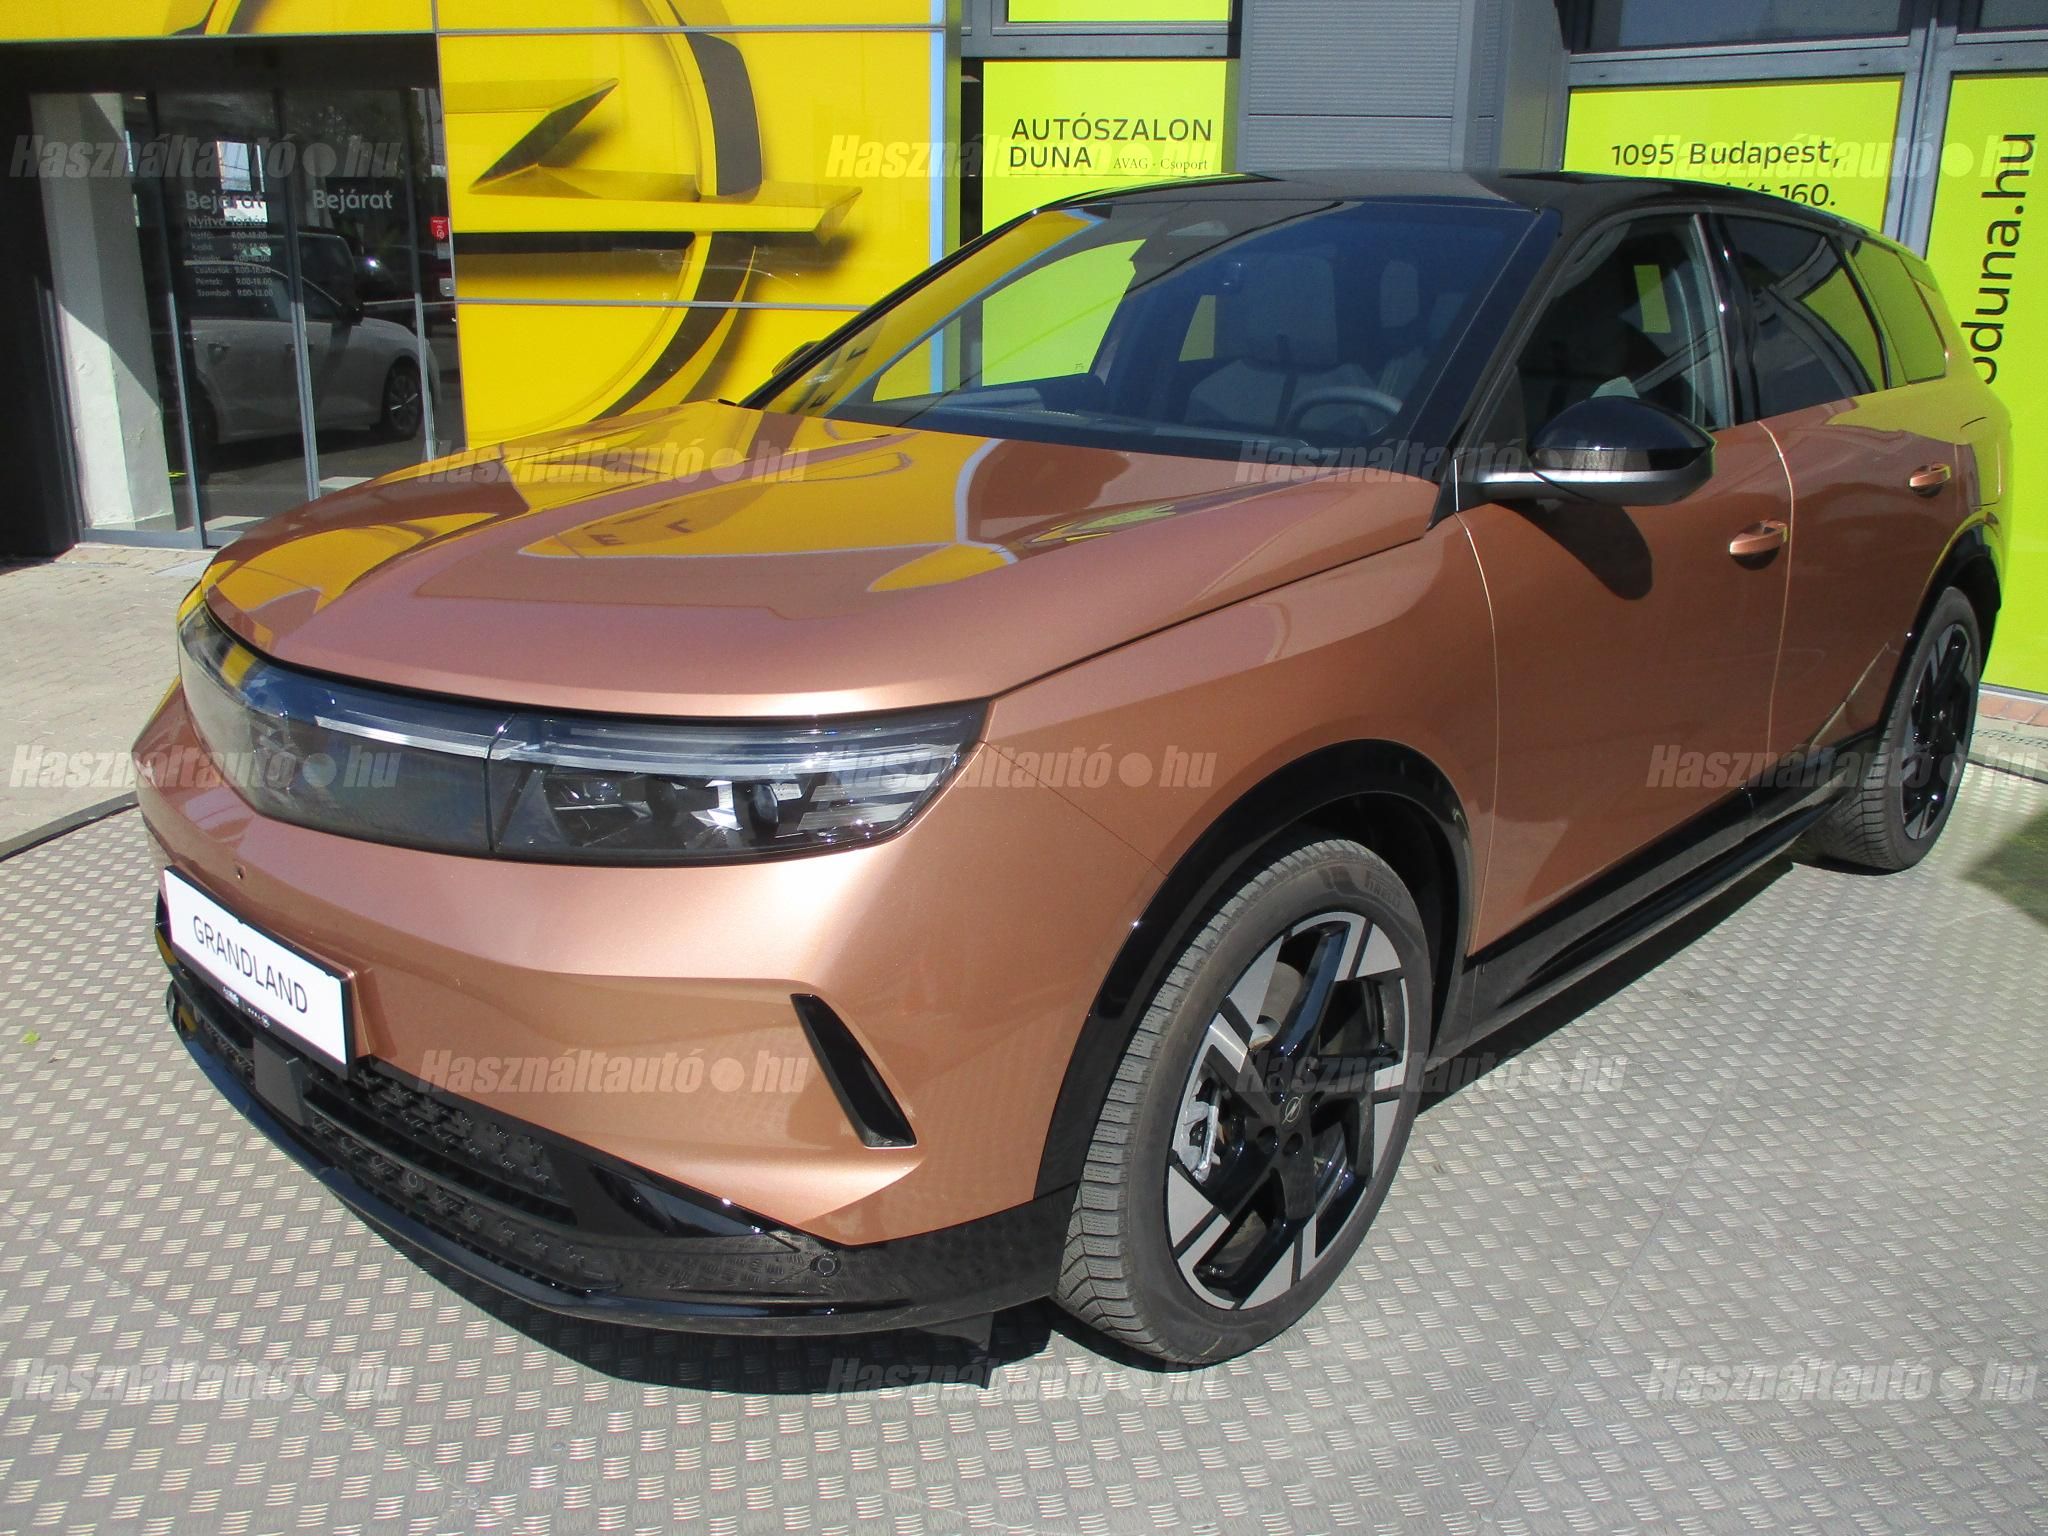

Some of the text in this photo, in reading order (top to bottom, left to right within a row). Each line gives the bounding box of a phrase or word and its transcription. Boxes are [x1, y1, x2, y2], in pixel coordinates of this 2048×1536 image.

[1011, 112, 1212, 141] AUTÓSZALON
[1010, 146, 1208, 173] DUNA AVAG Csoport
[1611, 140, 1840, 169] 1095 Budapest,
[185, 189, 264, 214] Bejárat
[312, 188, 393, 214] Bejárat
[193, 915, 308, 1014] GRANDLAND
